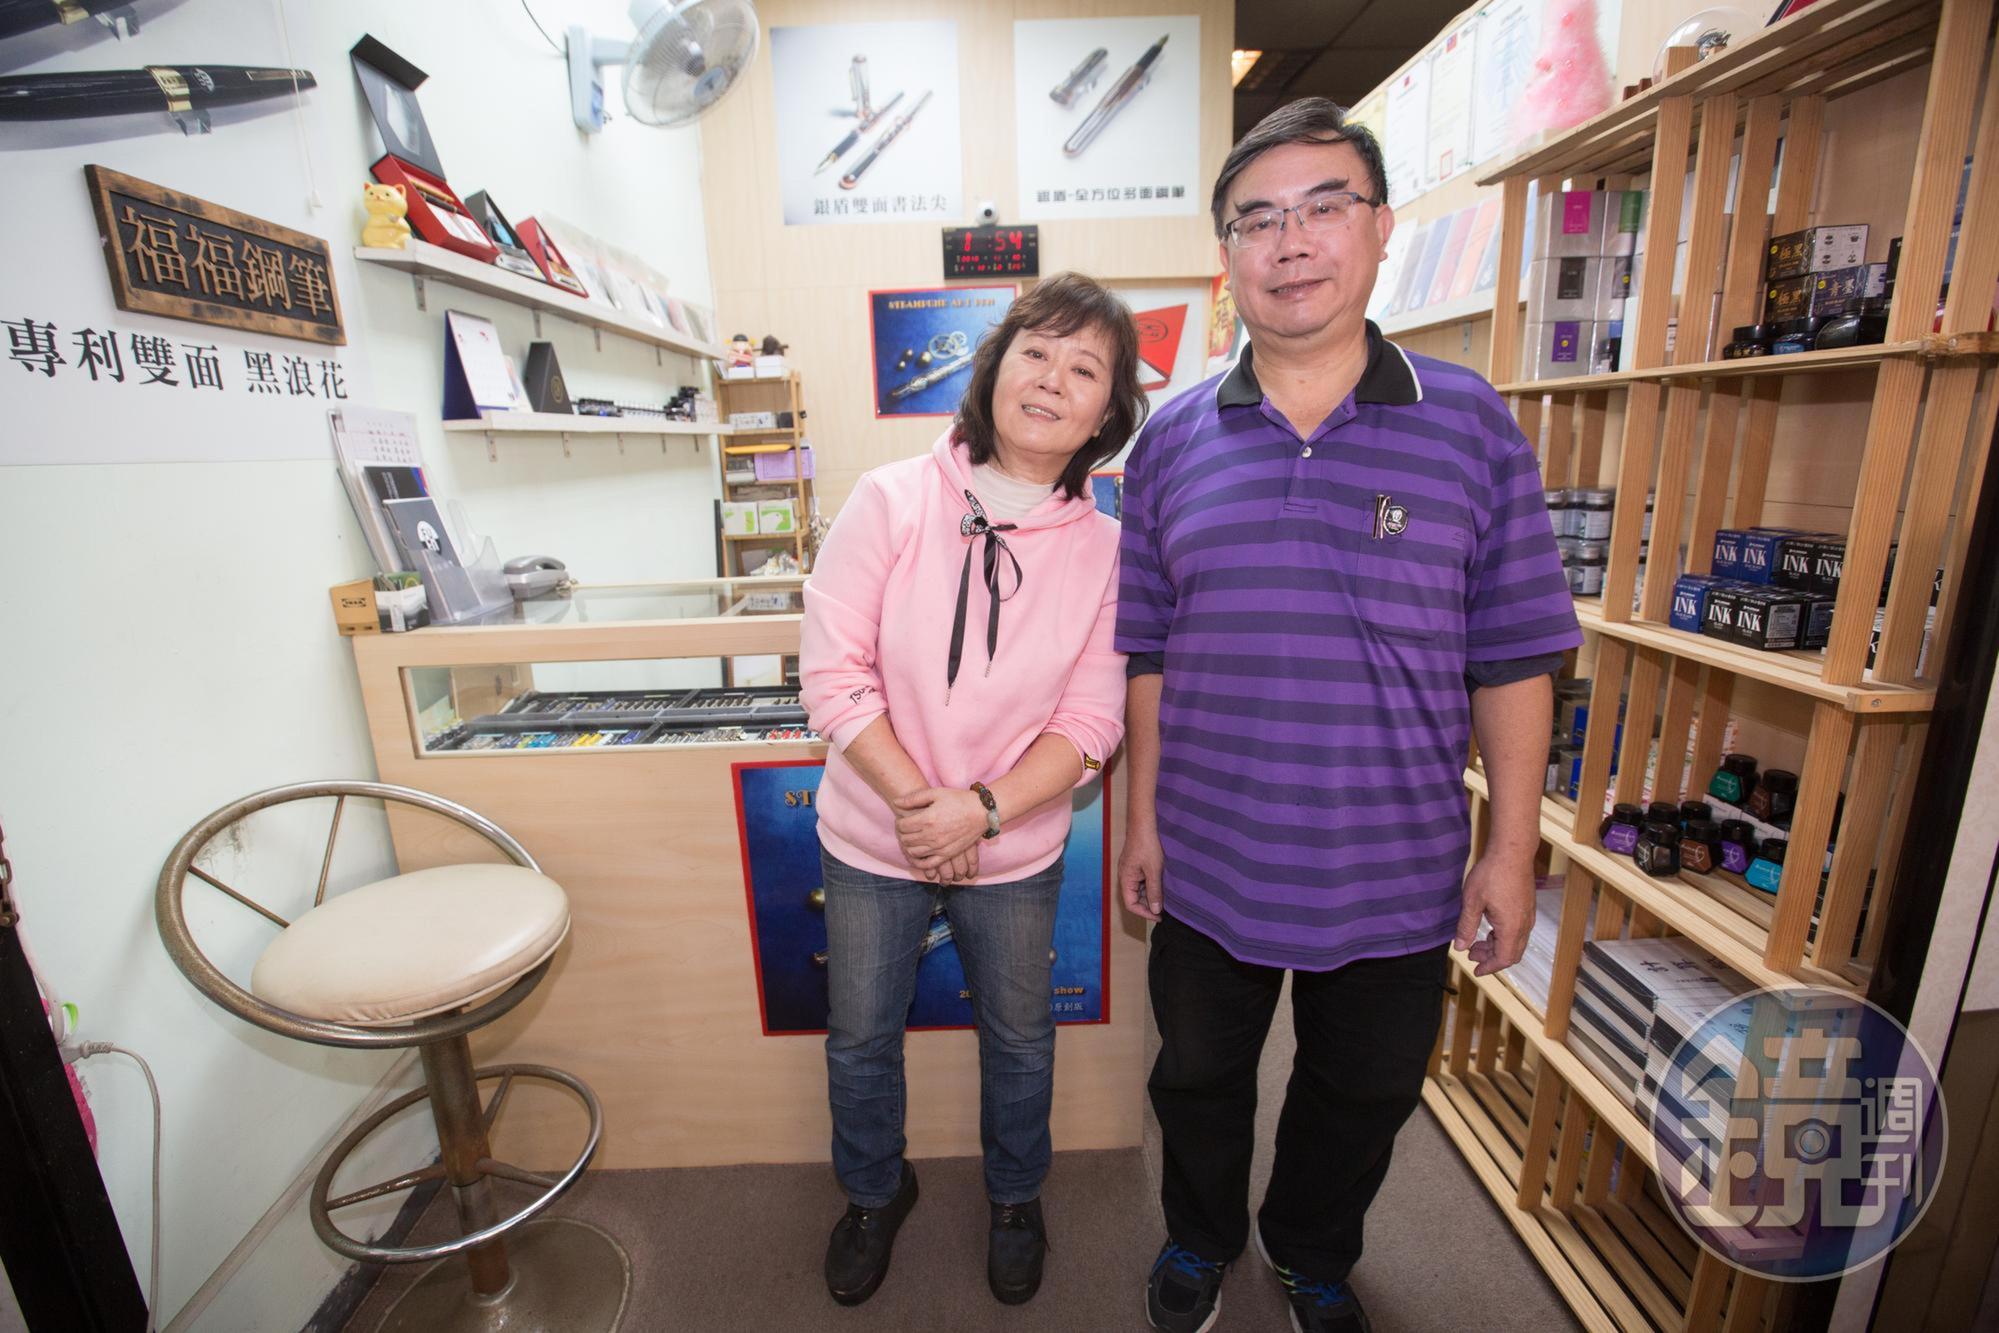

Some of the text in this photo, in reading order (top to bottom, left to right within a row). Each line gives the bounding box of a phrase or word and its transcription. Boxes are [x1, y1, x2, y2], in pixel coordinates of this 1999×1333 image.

[121, 205, 332, 317] 福福鋼筆
[0, 317, 348, 400] 專利雙面 黑浪花
[1715, 544, 1843, 578] INK INK INK INK
[1673, 596, 1697, 616] INK
[1708, 604, 1733, 625] INK
[1737, 610, 1762, 633] INK
[1053, 986, 1084, 995] show
